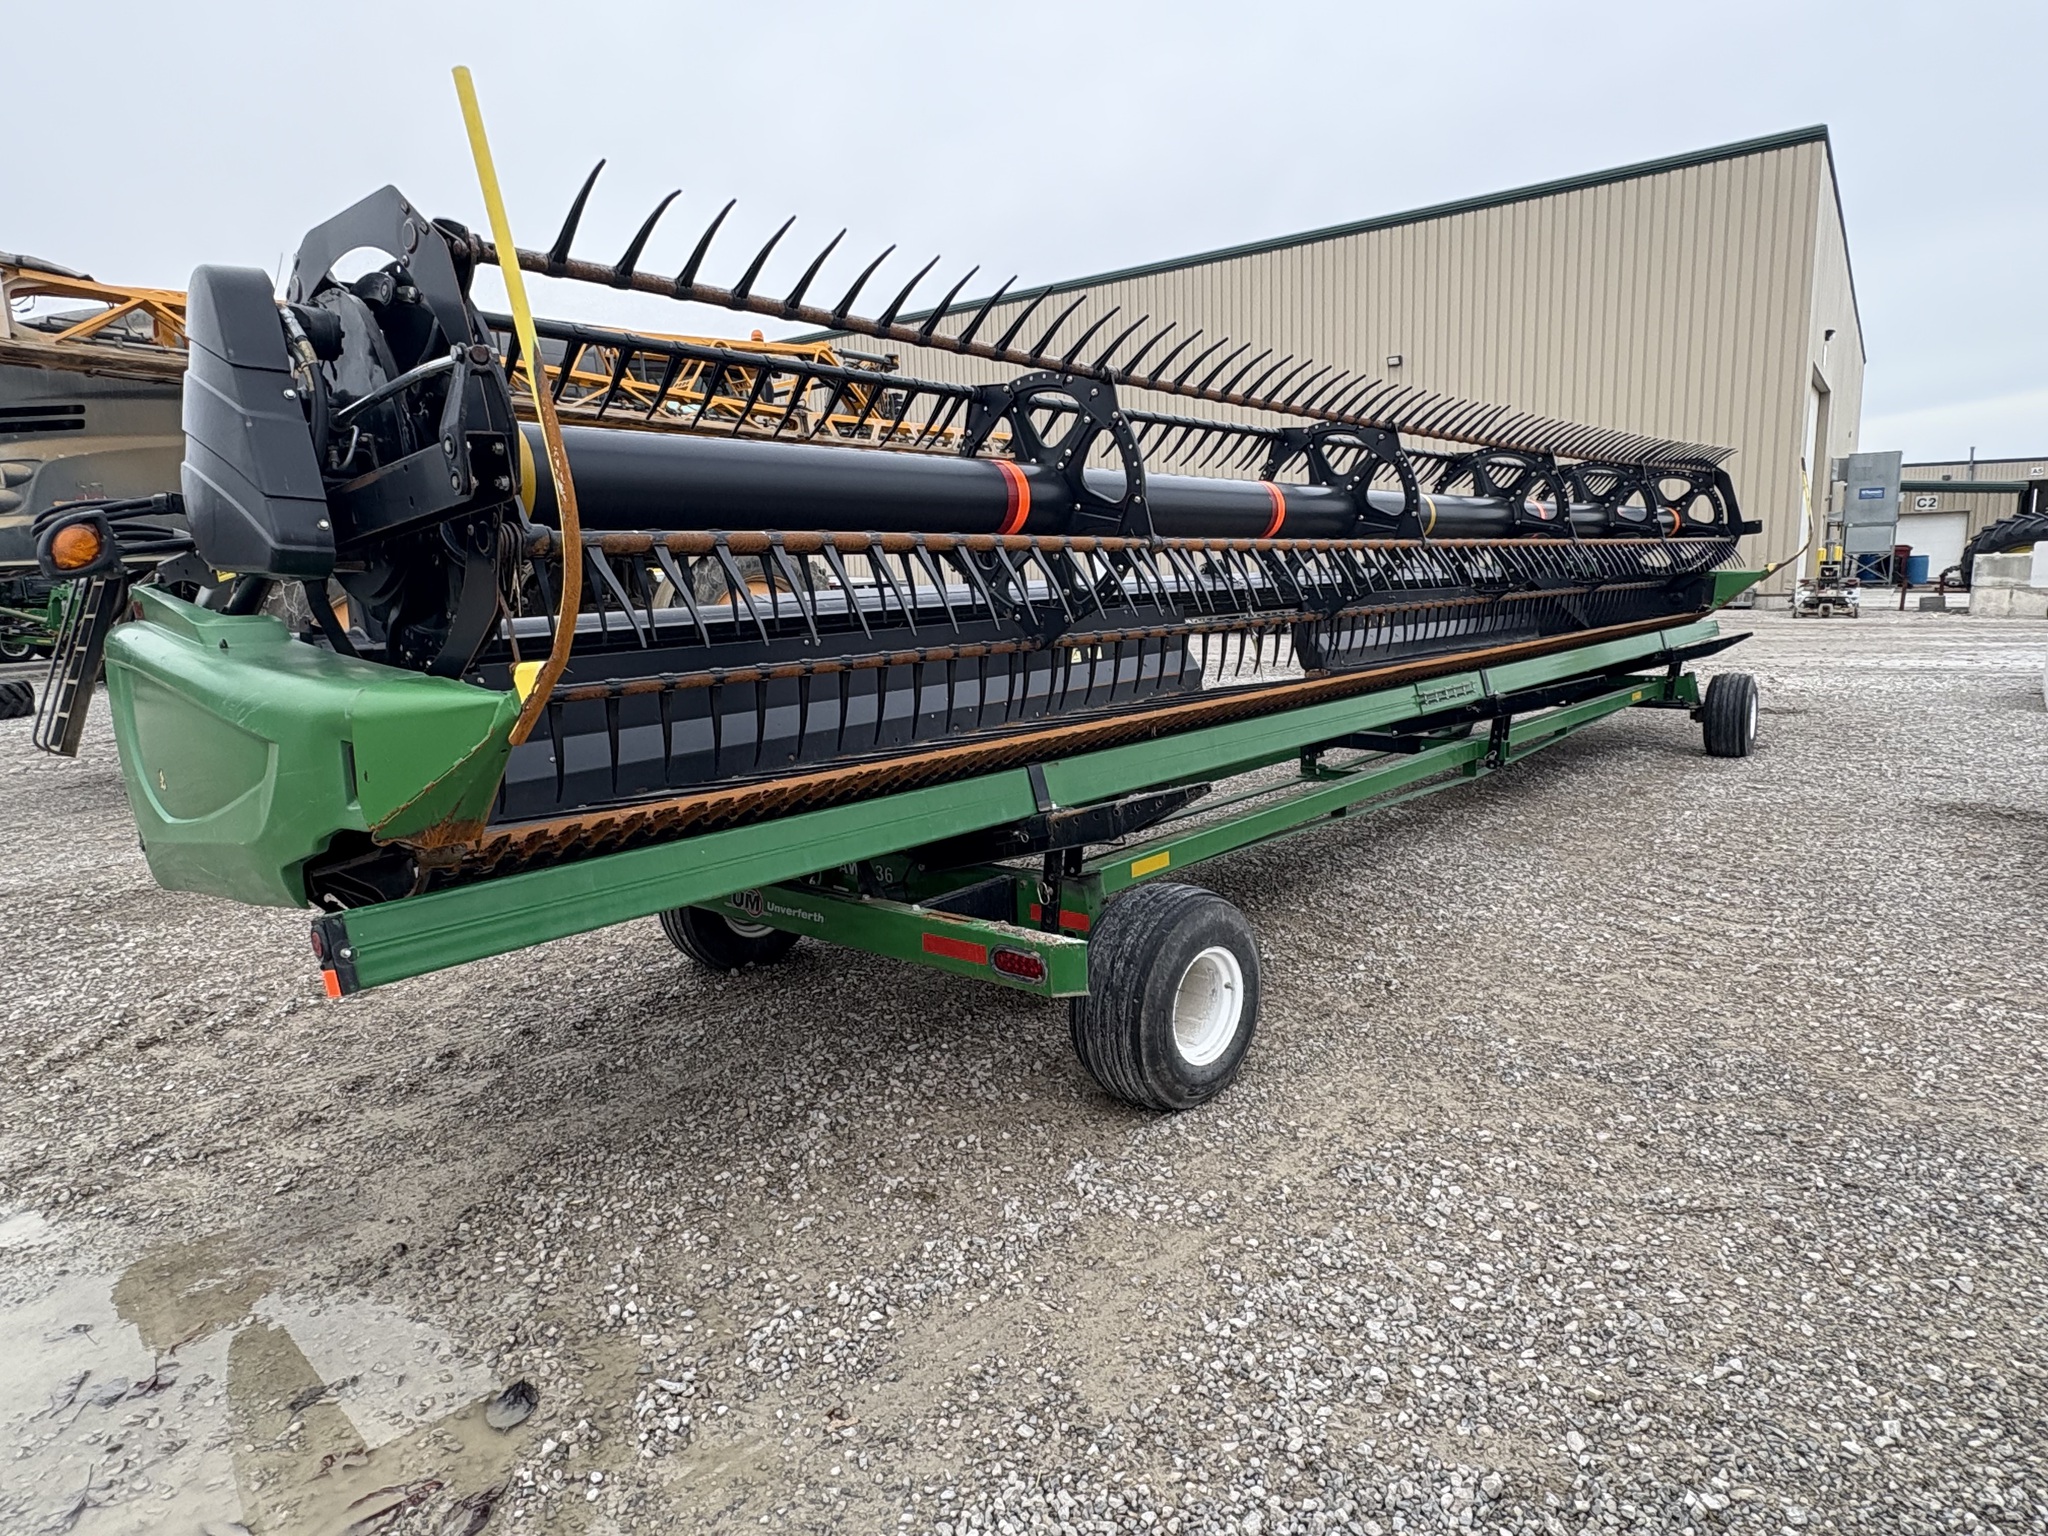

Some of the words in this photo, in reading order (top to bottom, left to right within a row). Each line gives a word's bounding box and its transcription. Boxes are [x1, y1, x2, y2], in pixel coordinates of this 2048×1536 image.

[1917, 497, 1937, 508] C2
[876, 865, 894, 883] 36
[767, 901, 825, 923] Unverferth
